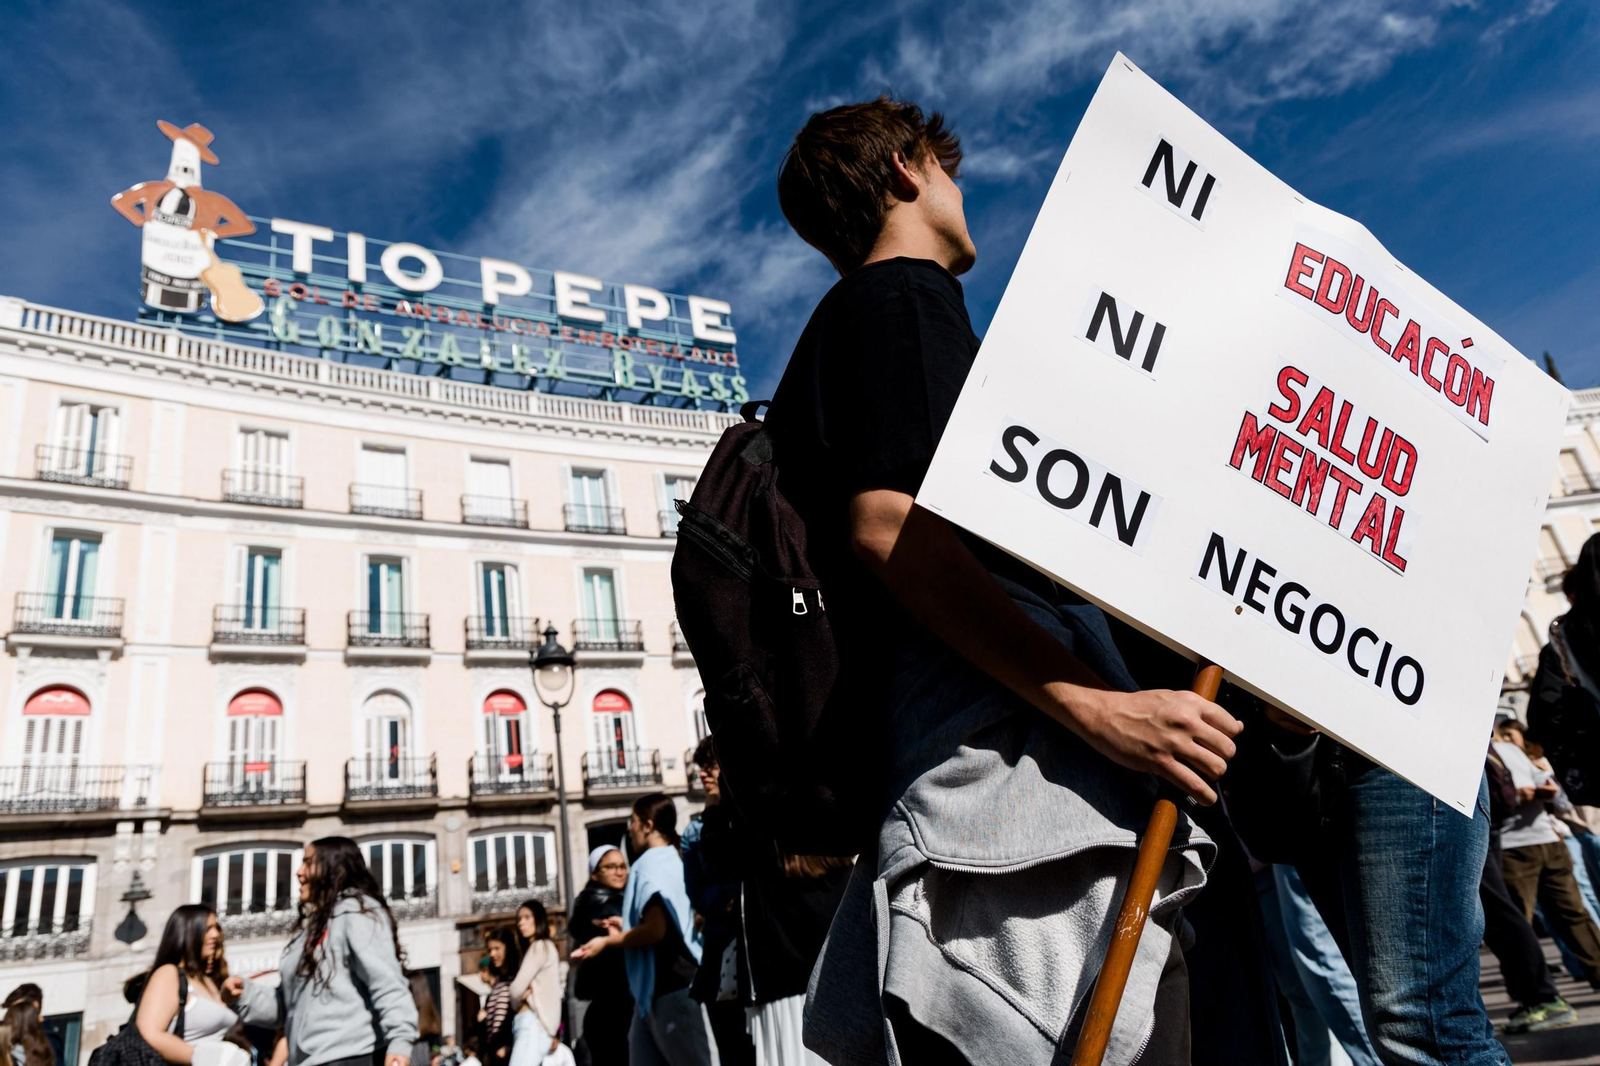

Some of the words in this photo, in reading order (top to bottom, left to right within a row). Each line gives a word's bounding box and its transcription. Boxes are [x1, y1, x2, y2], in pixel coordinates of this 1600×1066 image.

[264, 278, 329, 304] SOL
[342, 291, 380, 312] DE
[394, 300, 550, 337] ANDALUCIA
[561, 325, 738, 366] EMBOTELLADO
[271, 218, 443, 291] TIO
[480, 257, 737, 344] PEPE
[1086, 292, 1166, 372] NI
[1142, 139, 1216, 221] NI
[1285, 242, 1494, 426] EDUCACÓN
[270, 296, 566, 379] GONZALEZ
[613, 349, 750, 404] BYASS
[1229, 411, 1407, 572] MENTAL
[1268, 366, 1417, 496] SALUD
[990, 426, 1151, 547] SON
[1199, 532, 1424, 705] NEGOCIO
